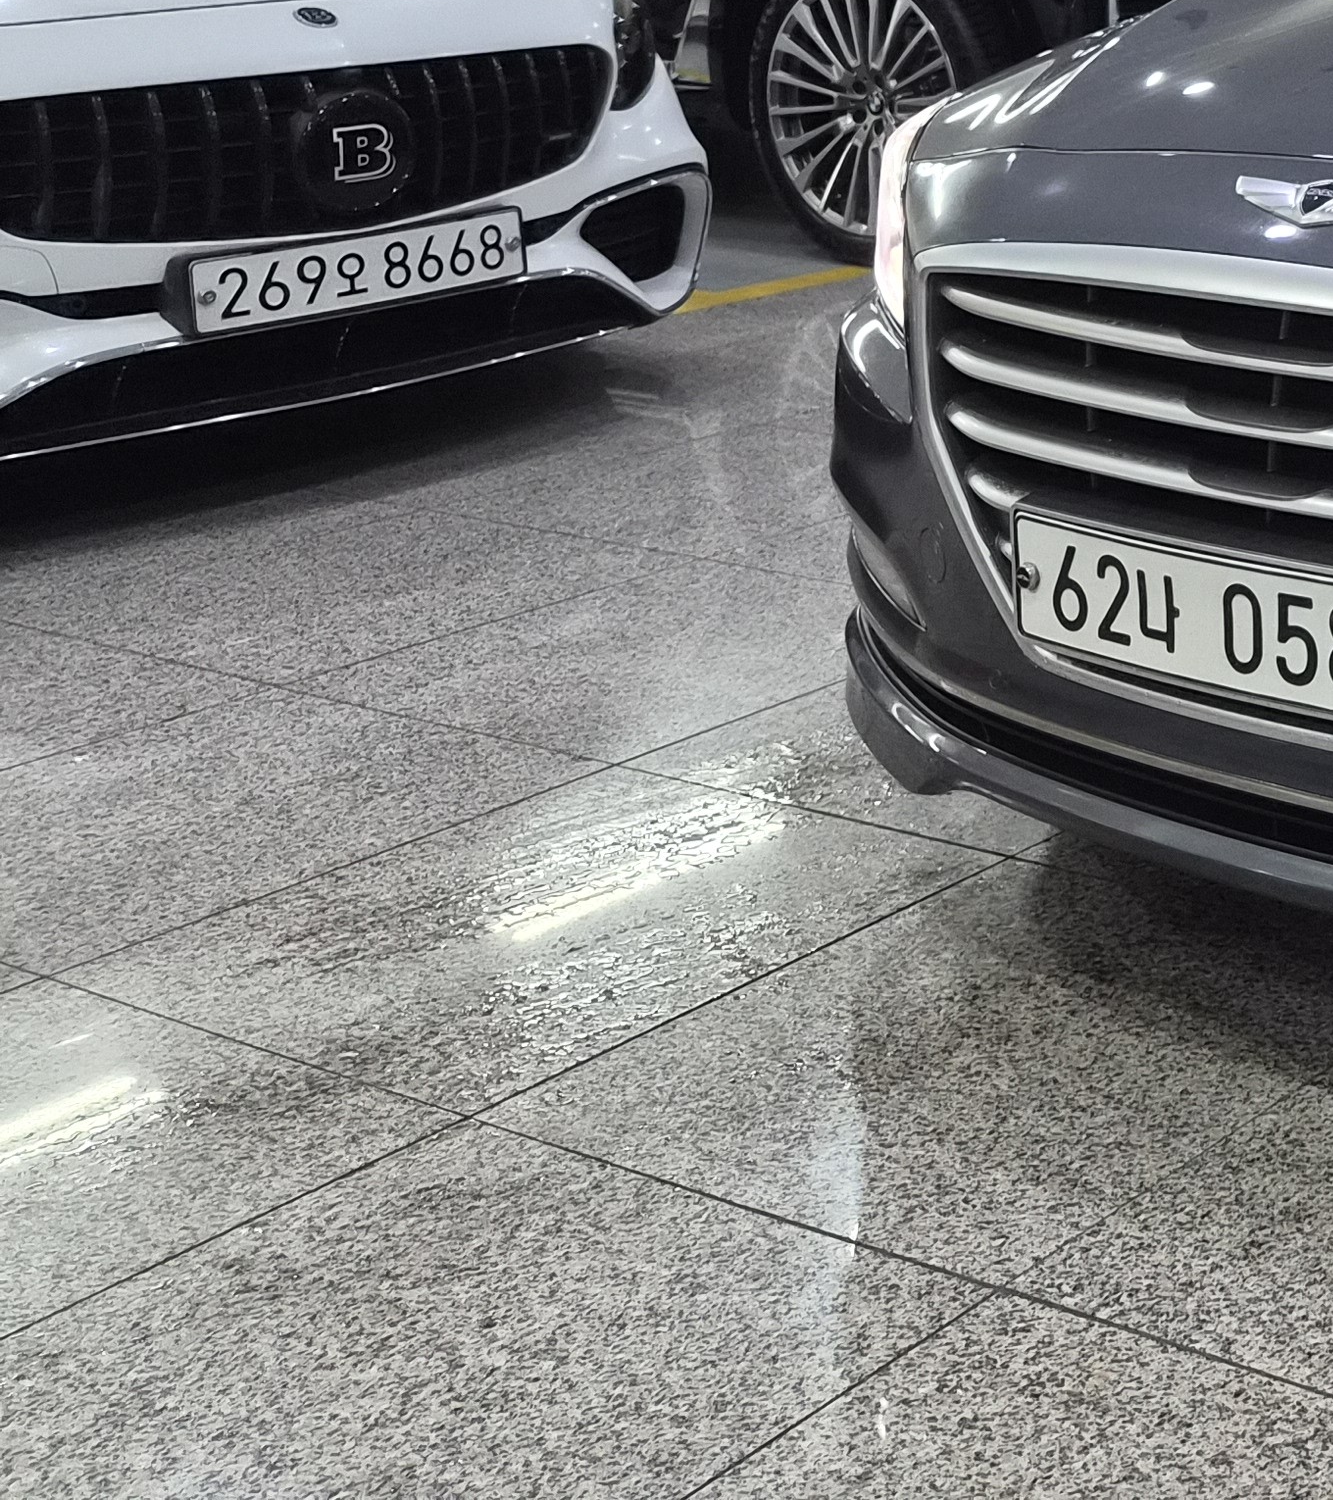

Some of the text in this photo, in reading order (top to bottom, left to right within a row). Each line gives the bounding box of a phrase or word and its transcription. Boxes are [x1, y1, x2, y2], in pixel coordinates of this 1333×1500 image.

[332, 123, 396, 184] B
[217, 223, 506, 321] 269오 8668
[1052, 544, 1181, 654] 62나
